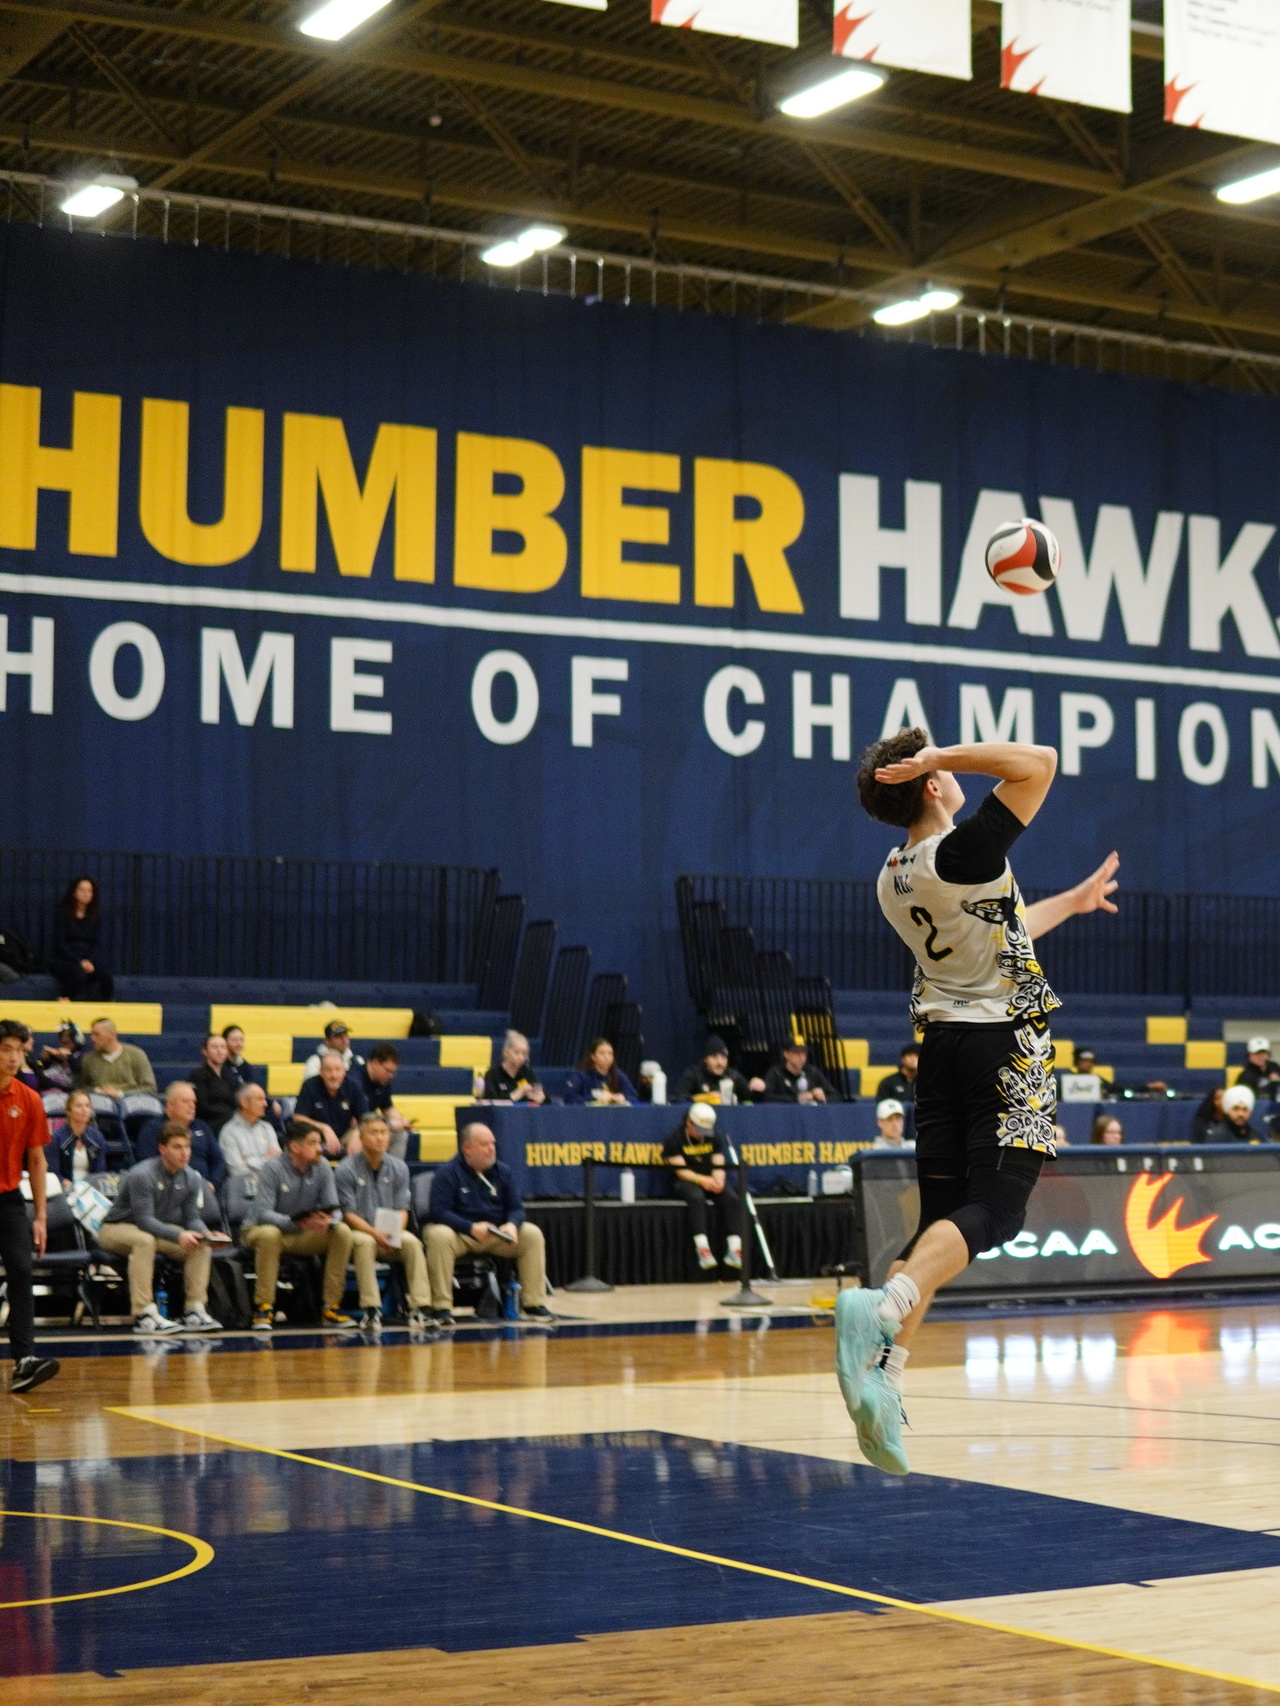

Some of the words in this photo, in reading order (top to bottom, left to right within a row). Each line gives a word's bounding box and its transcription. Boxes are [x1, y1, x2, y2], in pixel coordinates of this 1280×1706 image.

[0, 383, 804, 614] HUMBER
[0, 613, 393, 735] HOME
[471, 649, 629, 748] OF
[910, 905, 953, 962] 2
[526, 1142, 605, 1167] HUMBER
[609, 1142, 665, 1165] HAWK
[741, 1142, 815, 1167] HUMBER
[818, 1142, 876, 1164] HAW
[976, 1230, 1118, 1260] CAA
